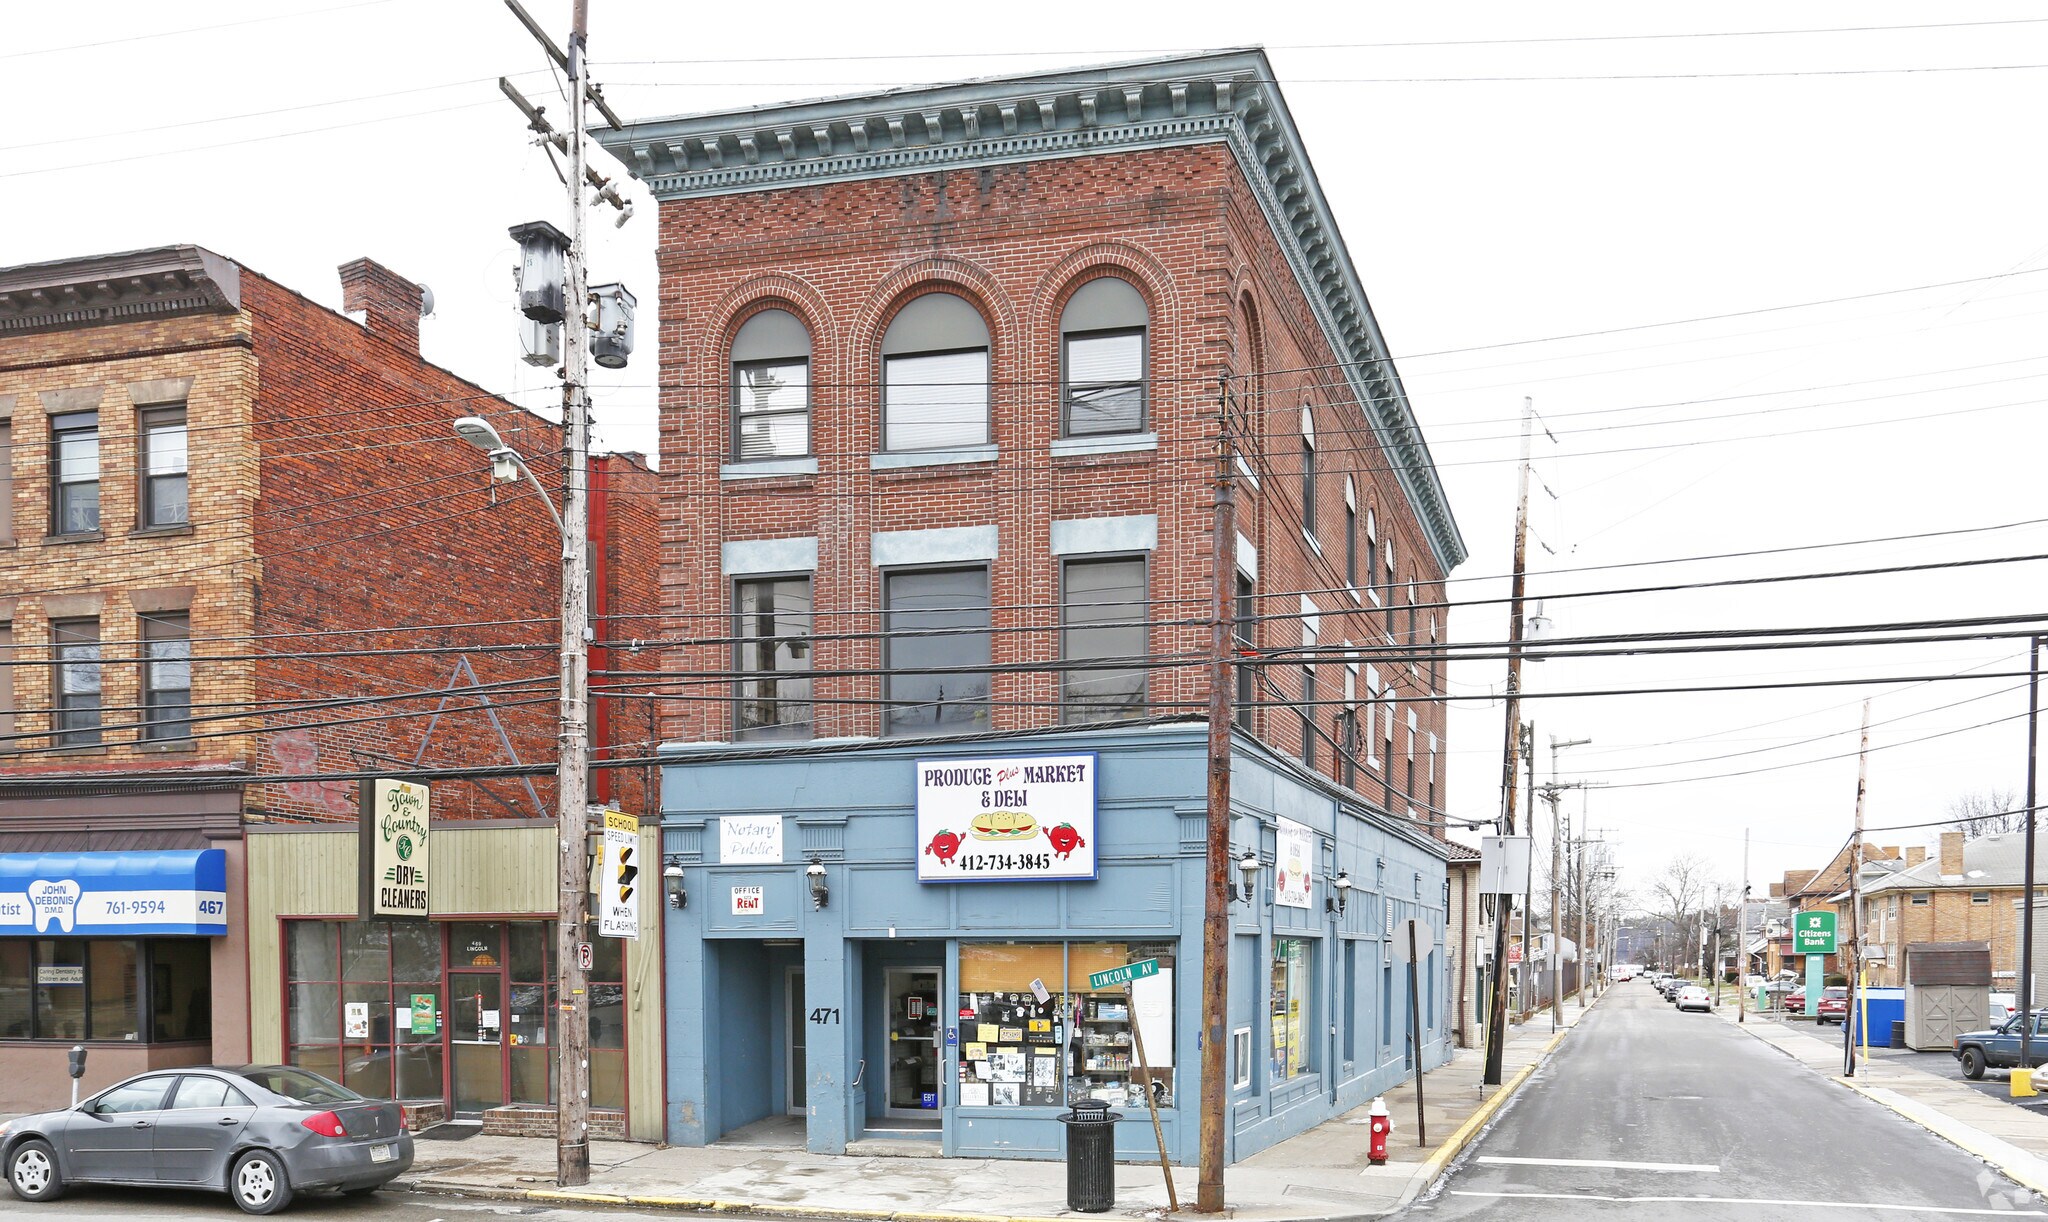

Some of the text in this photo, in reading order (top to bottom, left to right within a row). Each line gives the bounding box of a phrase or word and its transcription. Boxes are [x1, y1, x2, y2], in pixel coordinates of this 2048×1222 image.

[924, 764, 1086, 788] PRODUCE Plus MARKET
[387, 789, 425, 813] Town
[981, 789, 1028, 808] & DELI
[402, 807, 411, 817] &
[381, 814, 428, 848] Country
[608, 816, 636, 832] SCHOOL
[727, 822, 776, 839] Notary
[606, 830, 637, 845] SPEED LIMIT
[730, 841, 774, 855] Public
[959, 853, 1051, 871] 412-734-3845
[396, 864, 416, 886] DRY
[42, 885, 67, 895] JOHN
[734, 886, 760, 895] OFFICE
[35, 896, 74, 905] DEBONIS
[381, 887, 427, 910] CLEANERS
[736, 897, 759, 909] RENT
[105, 900, 166, 915] 761-9594
[198, 901, 224, 915] 467
[612, 906, 633, 918] WHEN
[603, 920, 638, 932] FLASHING
[1798, 930, 1832, 938] Citizens
[1804, 938, 1825, 946] Bank
[1093, 962, 1153, 987] LINCOLN AV
[809, 1008, 840, 1025] 471
[923, 1093, 935, 1102] EBT
